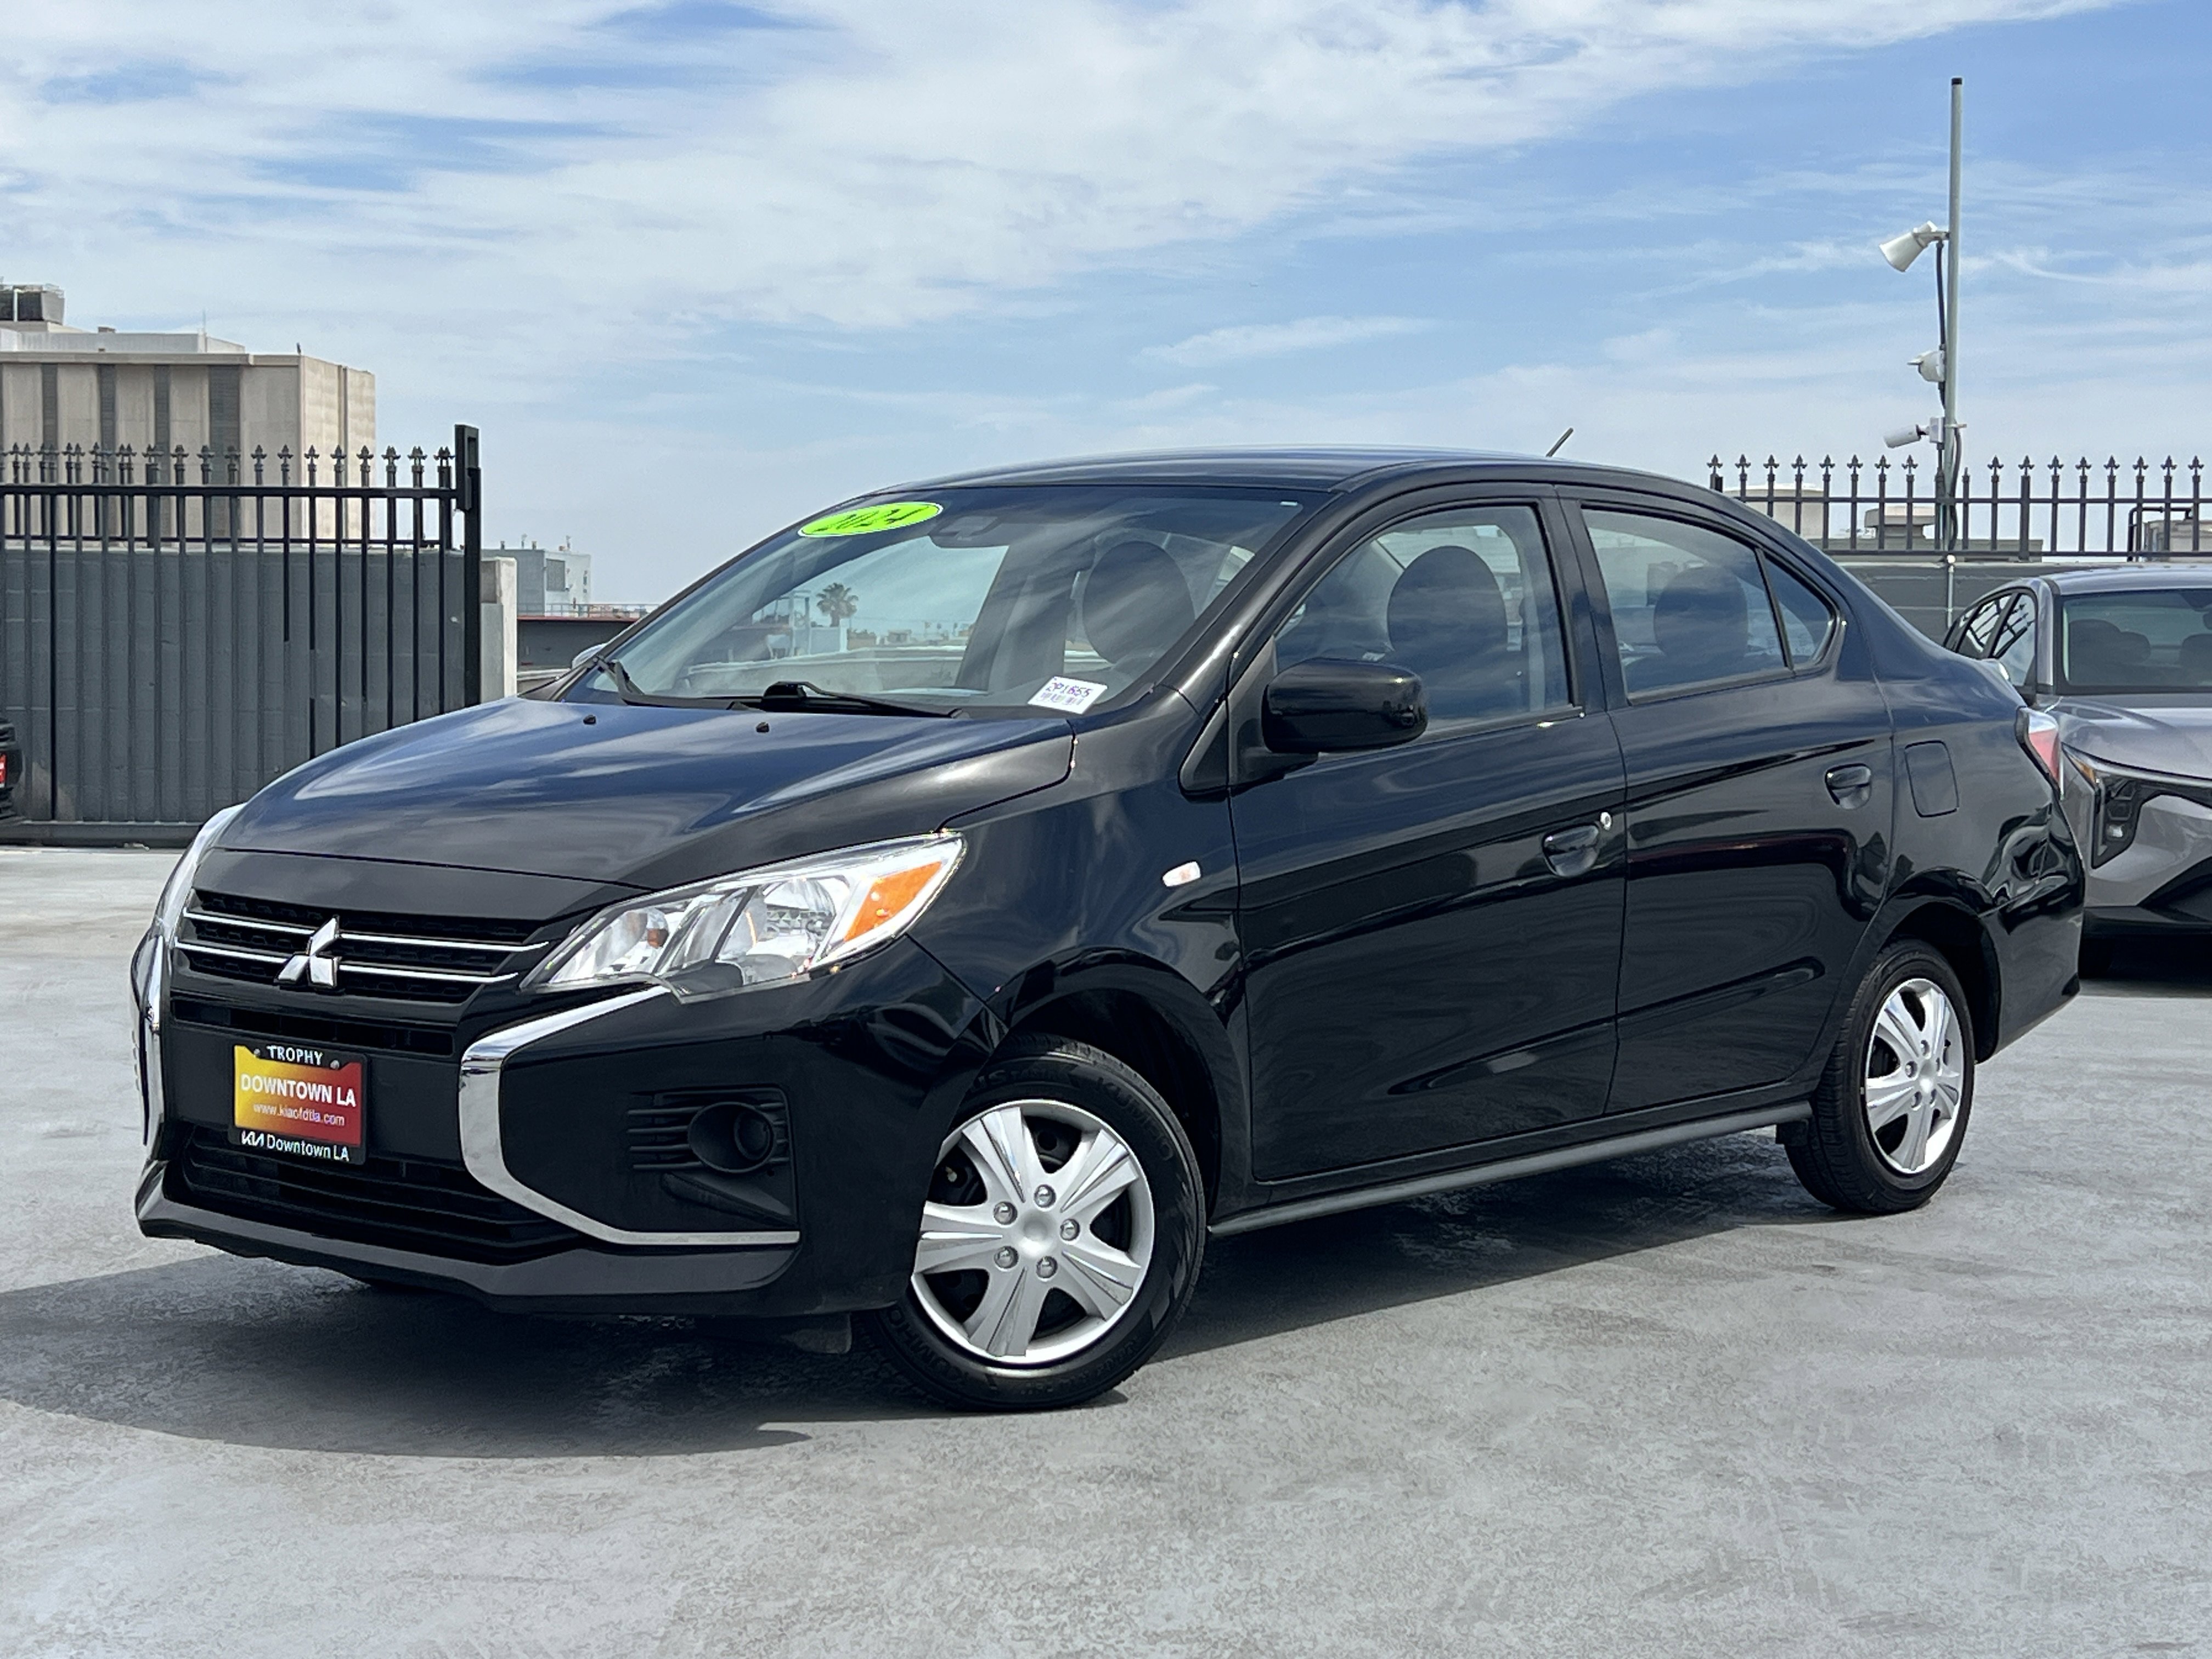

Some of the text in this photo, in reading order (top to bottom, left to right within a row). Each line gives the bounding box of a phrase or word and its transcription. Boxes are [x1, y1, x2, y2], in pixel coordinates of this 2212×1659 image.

[811, 506, 930, 533] 2024
[267, 1045, 323, 1065] TROPHY
[240, 1074, 356, 1107] DOWNTOWN LA
[253, 1103, 345, 1126] www.kiaofdtla.com
[241, 1130, 349, 1162] KIA Downtown LA
